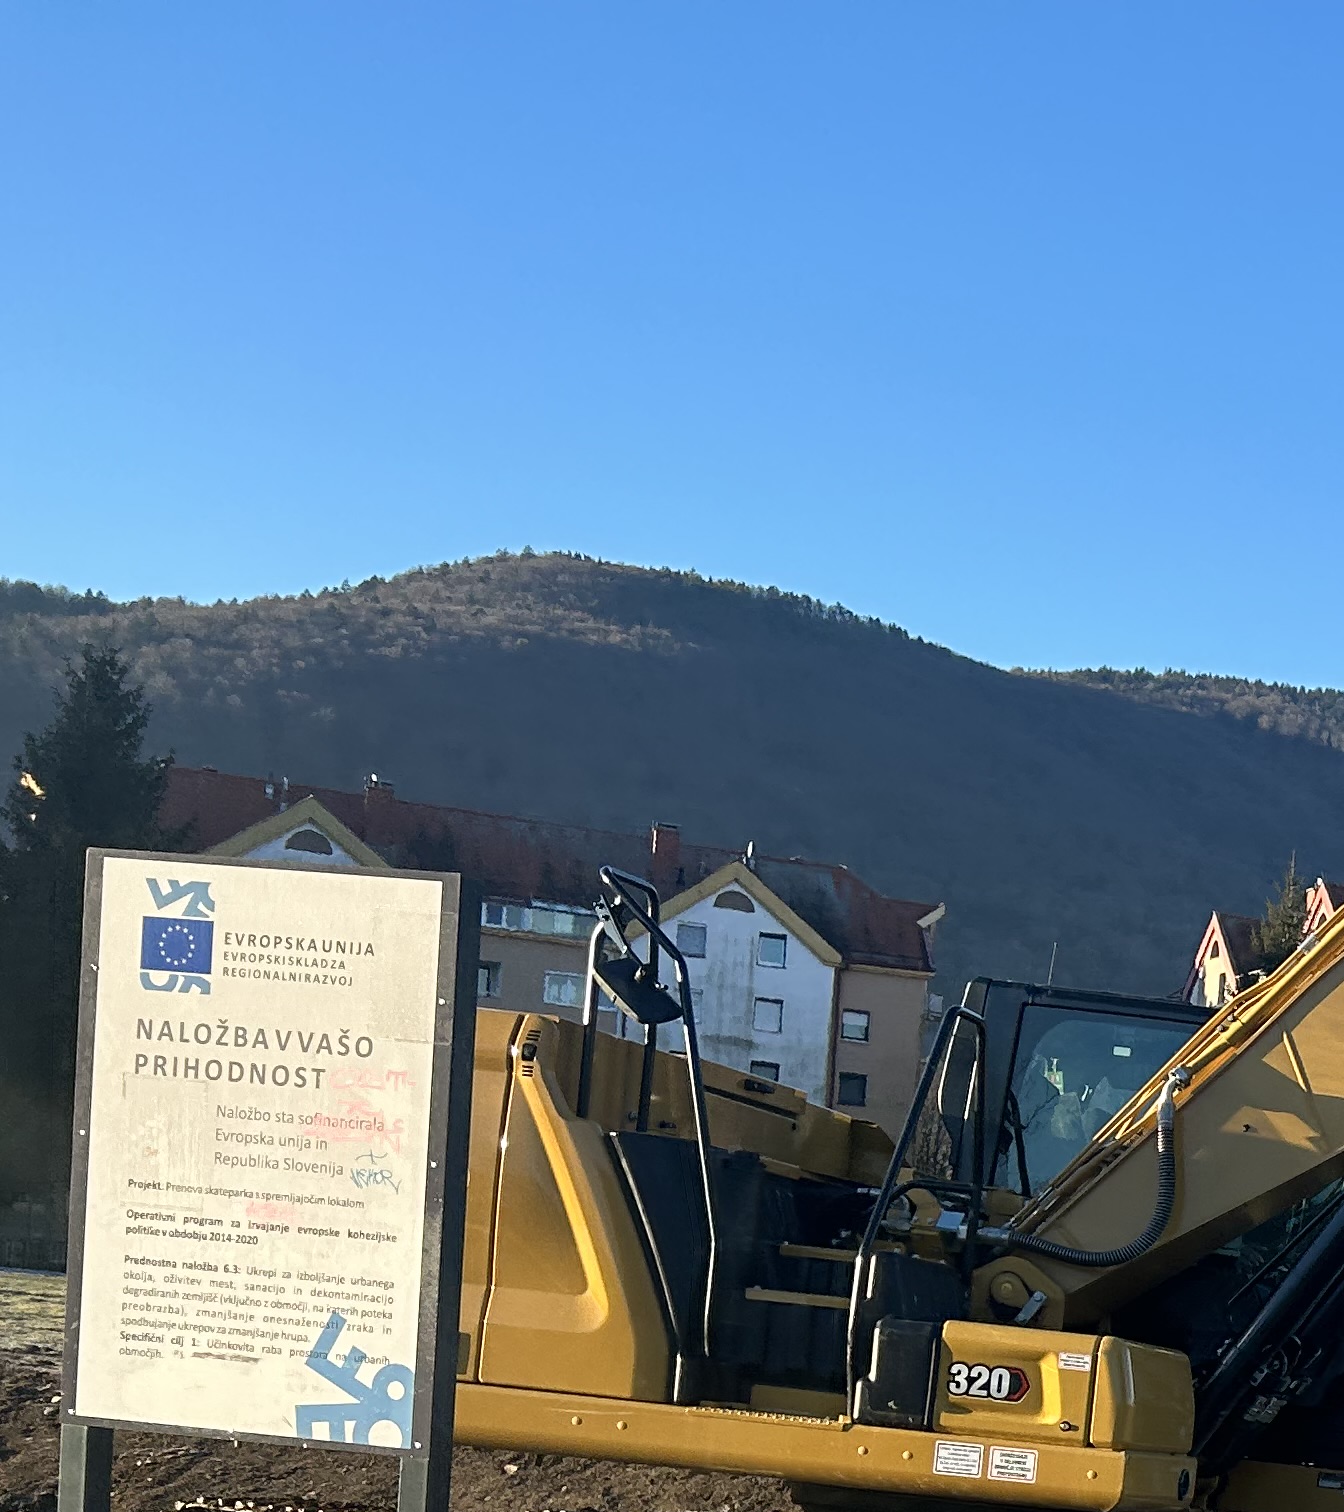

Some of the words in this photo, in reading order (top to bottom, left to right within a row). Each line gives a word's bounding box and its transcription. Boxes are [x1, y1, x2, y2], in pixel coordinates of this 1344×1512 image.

[136, 1018, 269, 1050] NALOŽBA
[298, 1028, 373, 1058] VAŠO
[135, 1054, 326, 1089] PRIHODNOST
[216, 1104, 270, 1122] Naložbo
[275, 1112, 294, 1124] sta
[298, 1112, 384, 1131] sofinancirala
[215, 1128, 274, 1146] Evropska
[278, 1135, 311, 1151] unija
[316, 1136, 328, 1151] in
[214, 1152, 279, 1169] Republika
[283, 1158, 344, 1178] Slovenija
[205, 1185, 253, 1198] skateparka
[261, 1192, 325, 1204] spremljajočim
[328, 1196, 364, 1208] lokalom
[127, 1209, 175, 1222] Operativni
[184, 1215, 223, 1227] program
[298, 1226, 340, 1237] evropske
[348, 1229, 397, 1243] kohezijske
[169, 1229, 207, 1242] obdobju
[209, 1232, 258, 1245] 2014-2020
[124, 1255, 177, 1268] Prednostna
[182, 1261, 218, 1272] naložba
[224, 1264, 241, 1274] 6.3:
[247, 1266, 276, 1279] Ukrepi
[297, 1270, 345, 1285] izboljšanje
[350, 1277, 394, 1290] urbanega
[124, 1270, 155, 1283] okolja,
[164, 1274, 201, 1285] oživitev
[244, 1283, 285, 1295] sanacijo
[293, 1286, 302, 1295] in
[310, 1287, 394, 1306] dekontaminacijo
[123, 1285, 179, 1299] degradiranih
[361, 1308, 393, 1320] poteka
[121, 1317, 176, 1331] spodbujanje
[178, 1322, 215, 1334] ukrepov
[228, 1328, 279, 1341] zmanjšanje
[196, 1309, 254, 1323] zmanjšanje
[263, 1316, 339, 1330] onesnaženosti
[347, 1322, 374, 1333] zraka
[383, 1326, 392, 1335] in
[120, 1331, 164, 1343] Specifični
[171, 1336, 184, 1347] cilj
[207, 1339, 254, 1353] Učinkovita
[262, 1345, 282, 1354] raba
[290, 1348, 327, 1360] prostora
[336, 1353, 347, 1361] na
[354, 1354, 390, 1366] urbanih
[950, 1363, 1010, 1399] 320
